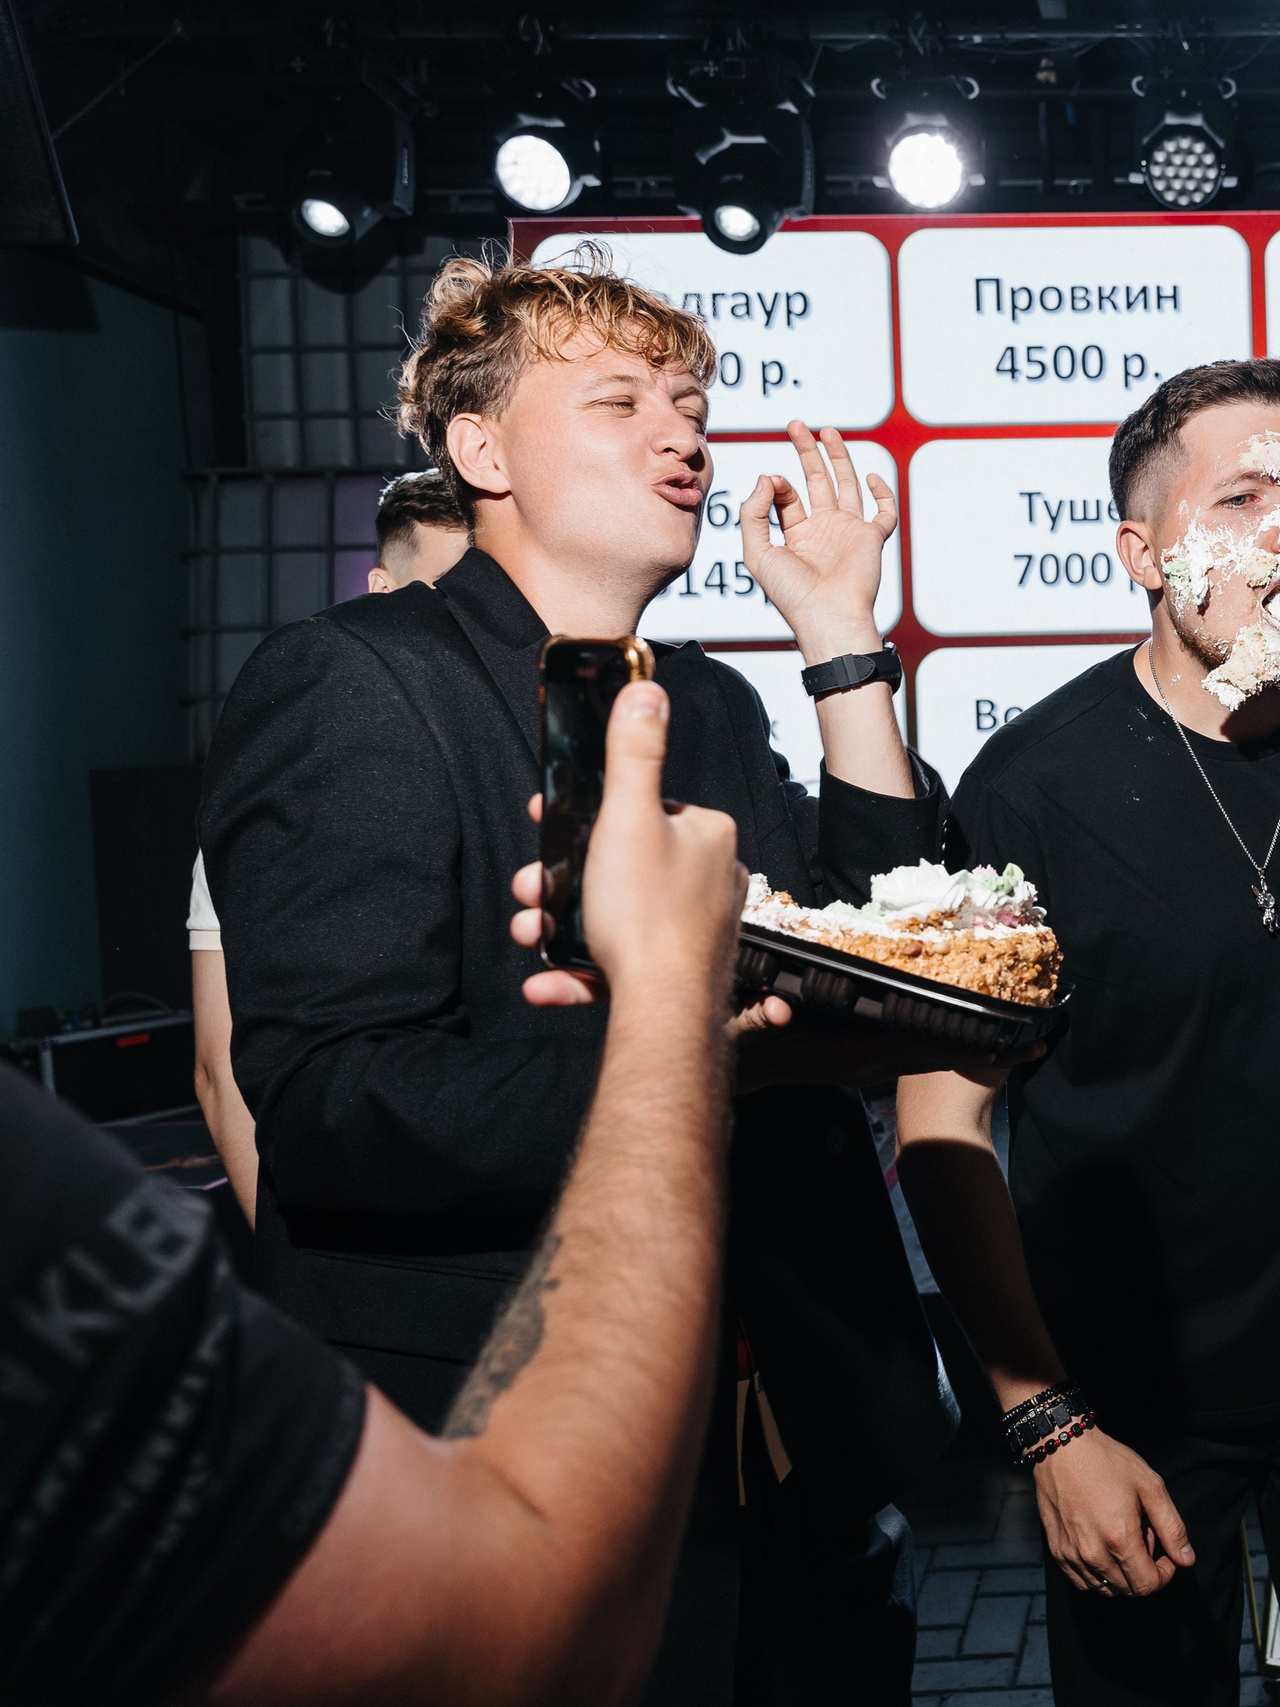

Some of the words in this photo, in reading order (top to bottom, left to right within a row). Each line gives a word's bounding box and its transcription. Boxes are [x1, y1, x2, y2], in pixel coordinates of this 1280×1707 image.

[974, 277, 1180, 323] Провкин
[995, 344, 1105, 381] 4500
[1018, 491, 1121, 532] Туше
[1013, 552, 1113, 586] 7000
